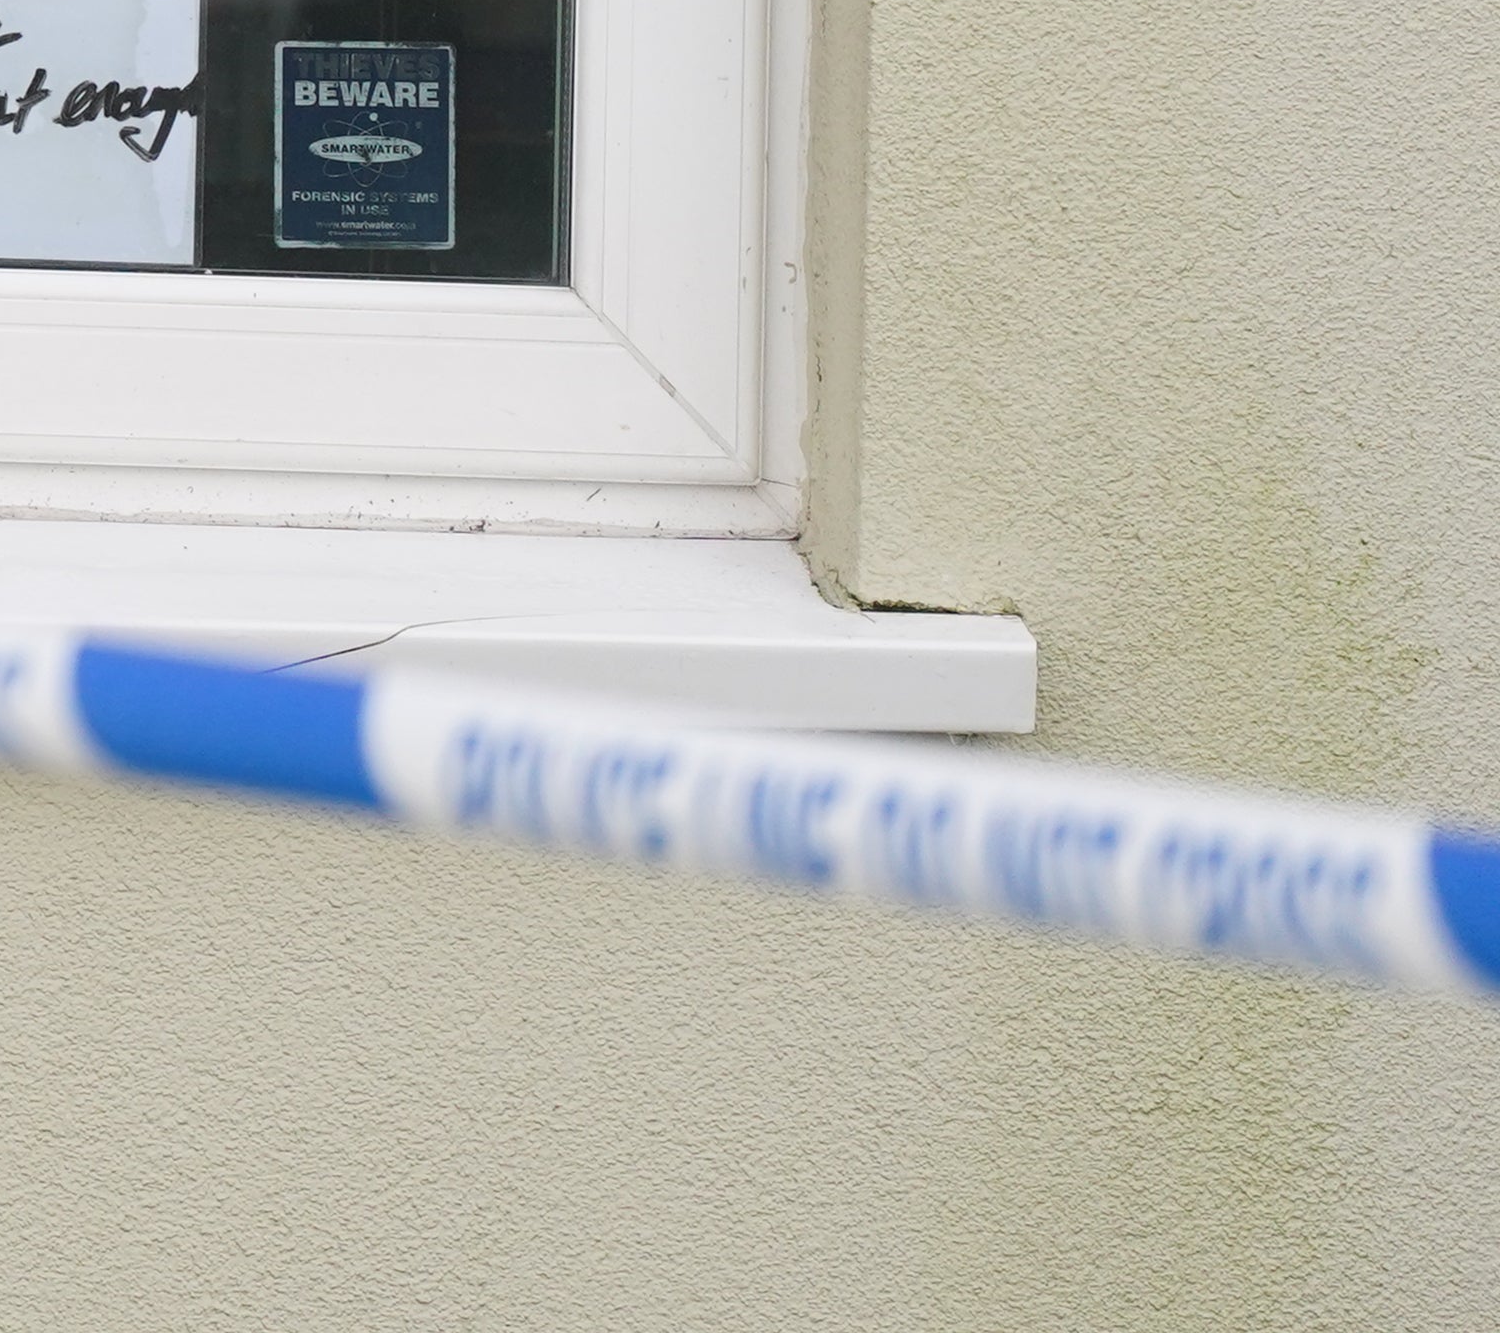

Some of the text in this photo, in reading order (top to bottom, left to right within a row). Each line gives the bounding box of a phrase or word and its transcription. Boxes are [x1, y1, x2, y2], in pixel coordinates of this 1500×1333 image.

[292, 52, 440, 79] THIEVES
[294, 81, 440, 108] BEWARE
[292, 190, 439, 203] FORENSIC SYSEMS
[341, 205, 390, 216] IN USE
